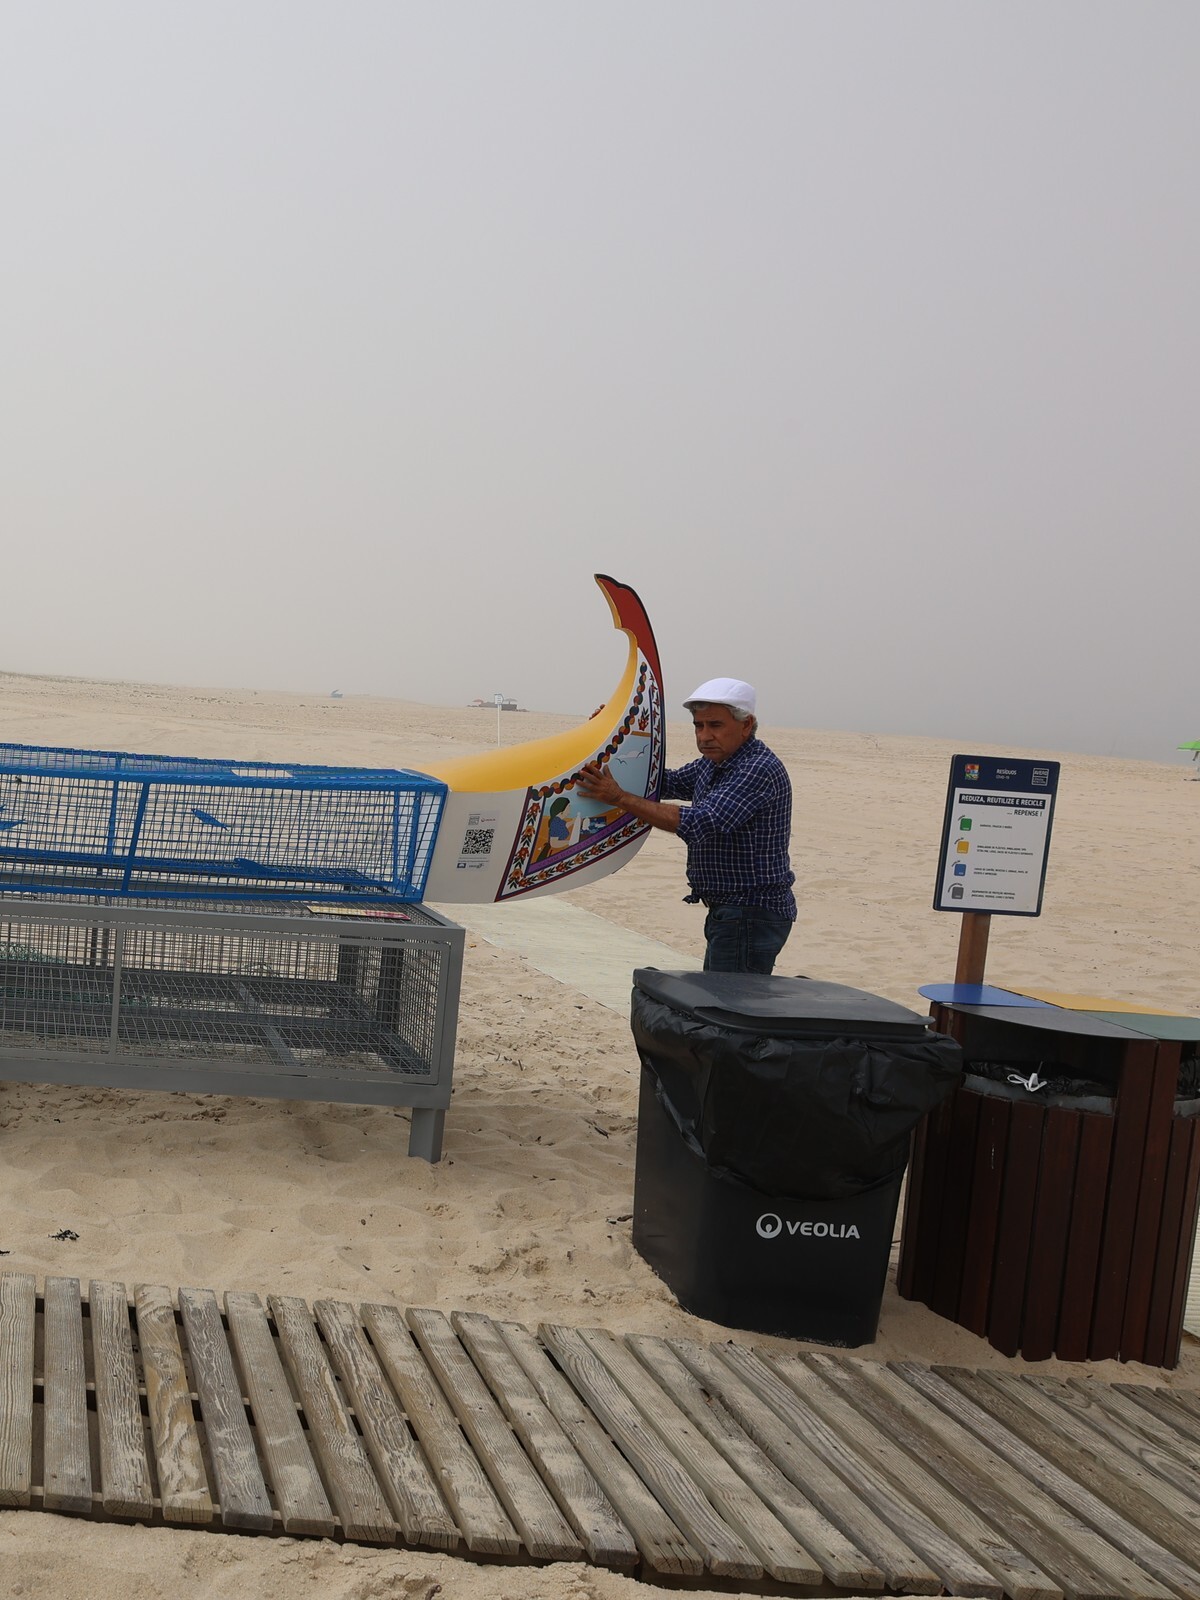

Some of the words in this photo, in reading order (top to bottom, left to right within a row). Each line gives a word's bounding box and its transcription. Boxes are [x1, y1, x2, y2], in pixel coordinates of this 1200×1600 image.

[987, 797, 1014, 805] REUTILIZE
[1013, 809, 1039, 817] REPENSE
[786, 1221, 860, 1239] VEOLIA
